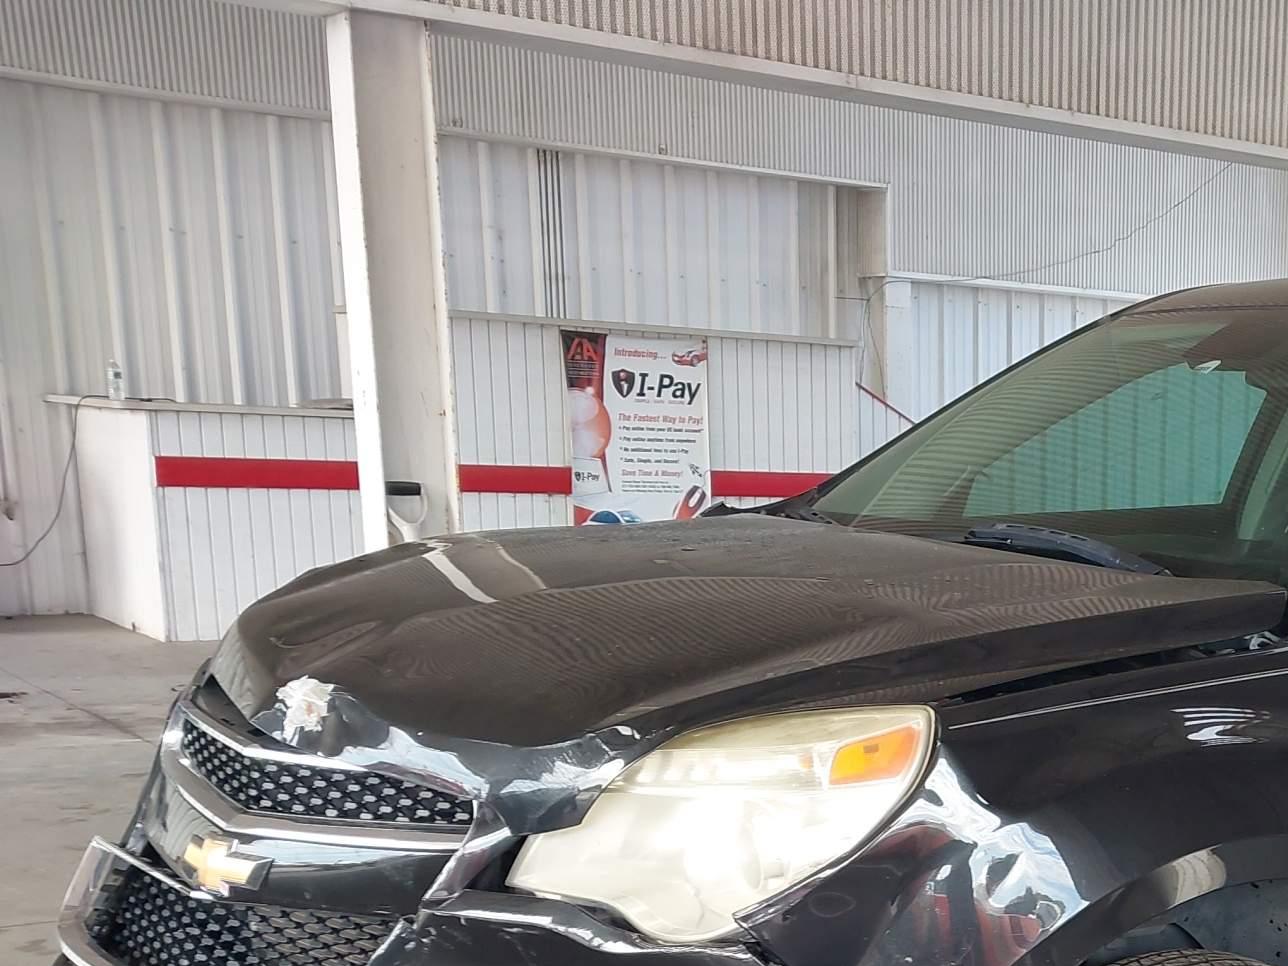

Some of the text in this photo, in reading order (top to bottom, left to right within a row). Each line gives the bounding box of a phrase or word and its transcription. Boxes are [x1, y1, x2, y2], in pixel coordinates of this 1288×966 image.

[636, 372, 702, 405] I-Pay
[618, 413, 631, 421] The
[633, 414, 660, 423] Fastest
[662, 415, 677, 424] Way
[687, 416, 703, 425] Pay!
[581, 472, 600, 482] I-Pay
